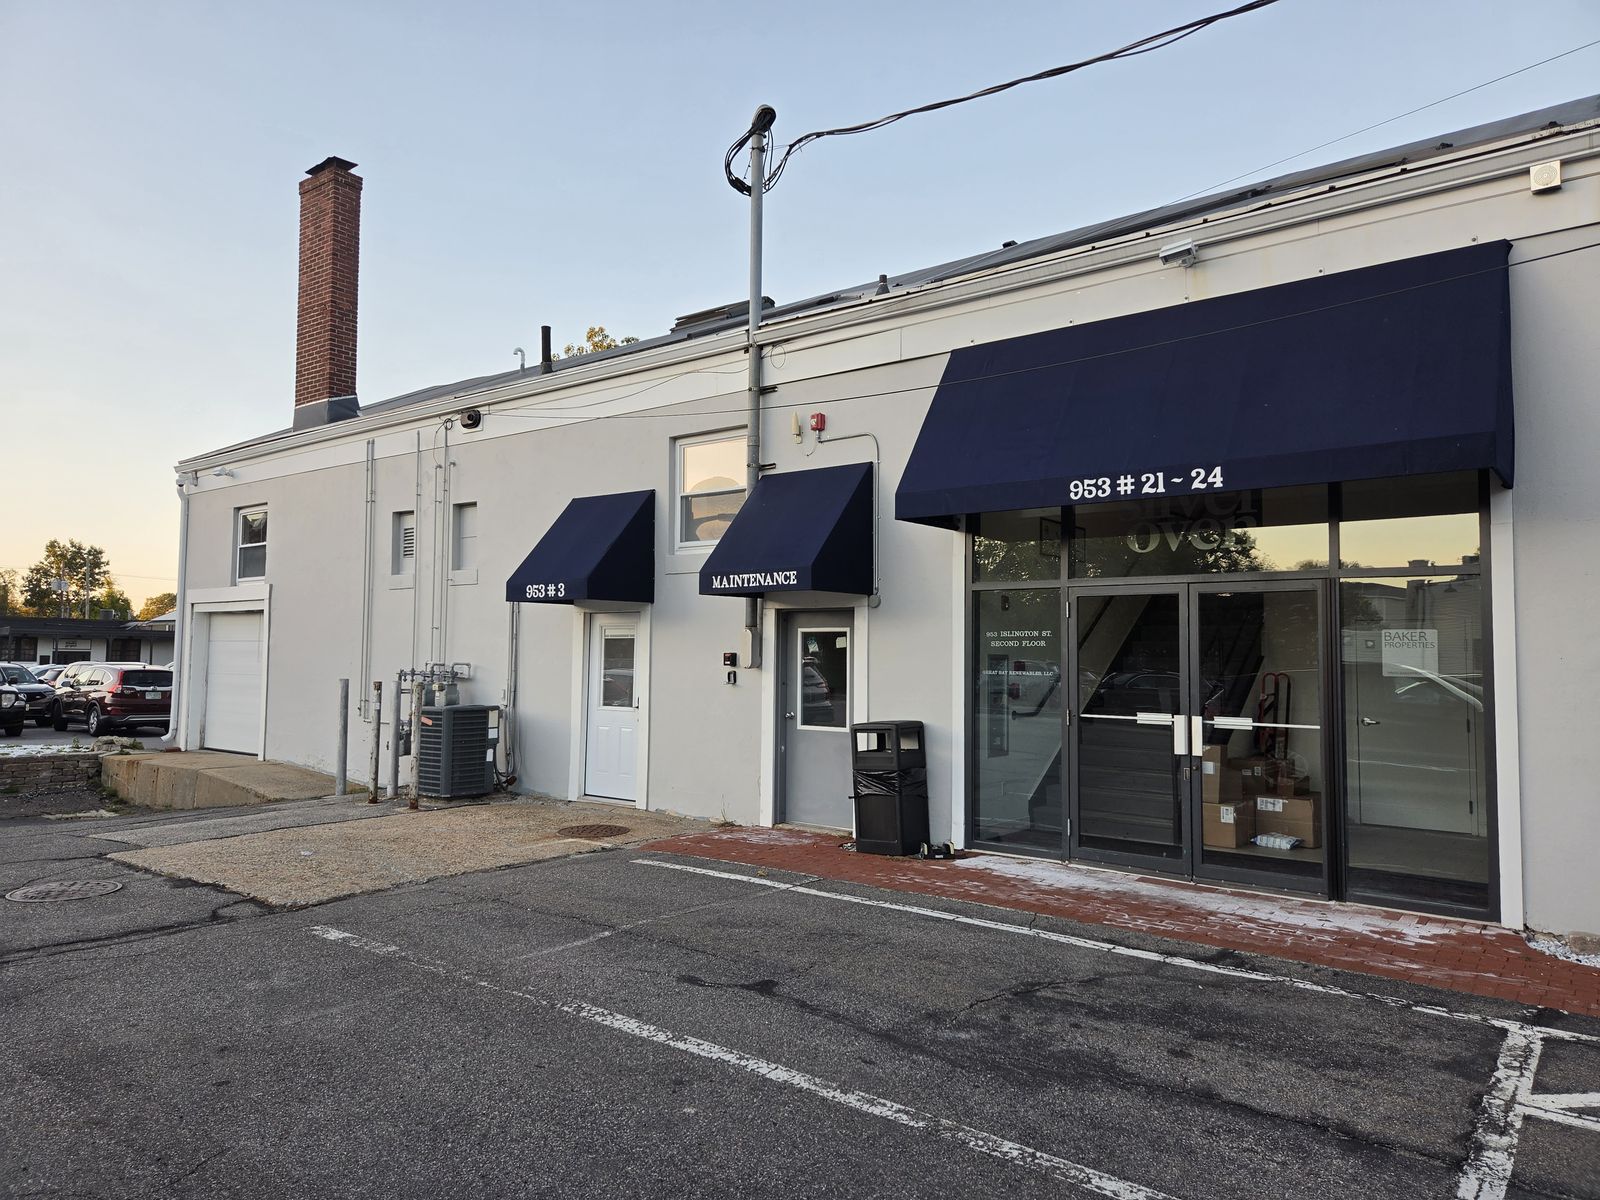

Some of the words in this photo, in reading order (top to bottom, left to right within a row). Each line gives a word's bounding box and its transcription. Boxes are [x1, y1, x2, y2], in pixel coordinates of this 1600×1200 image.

[1069, 477, 1111, 500] 953
[1141, 472, 1166, 494] 21
[1190, 466, 1224, 490] 24
[712, 571, 797, 588] MAINTENANCE
[526, 584, 546, 598] 953
[1384, 631, 1428, 641] BAKER
[1384, 641, 1436, 649] PROPERTIES
